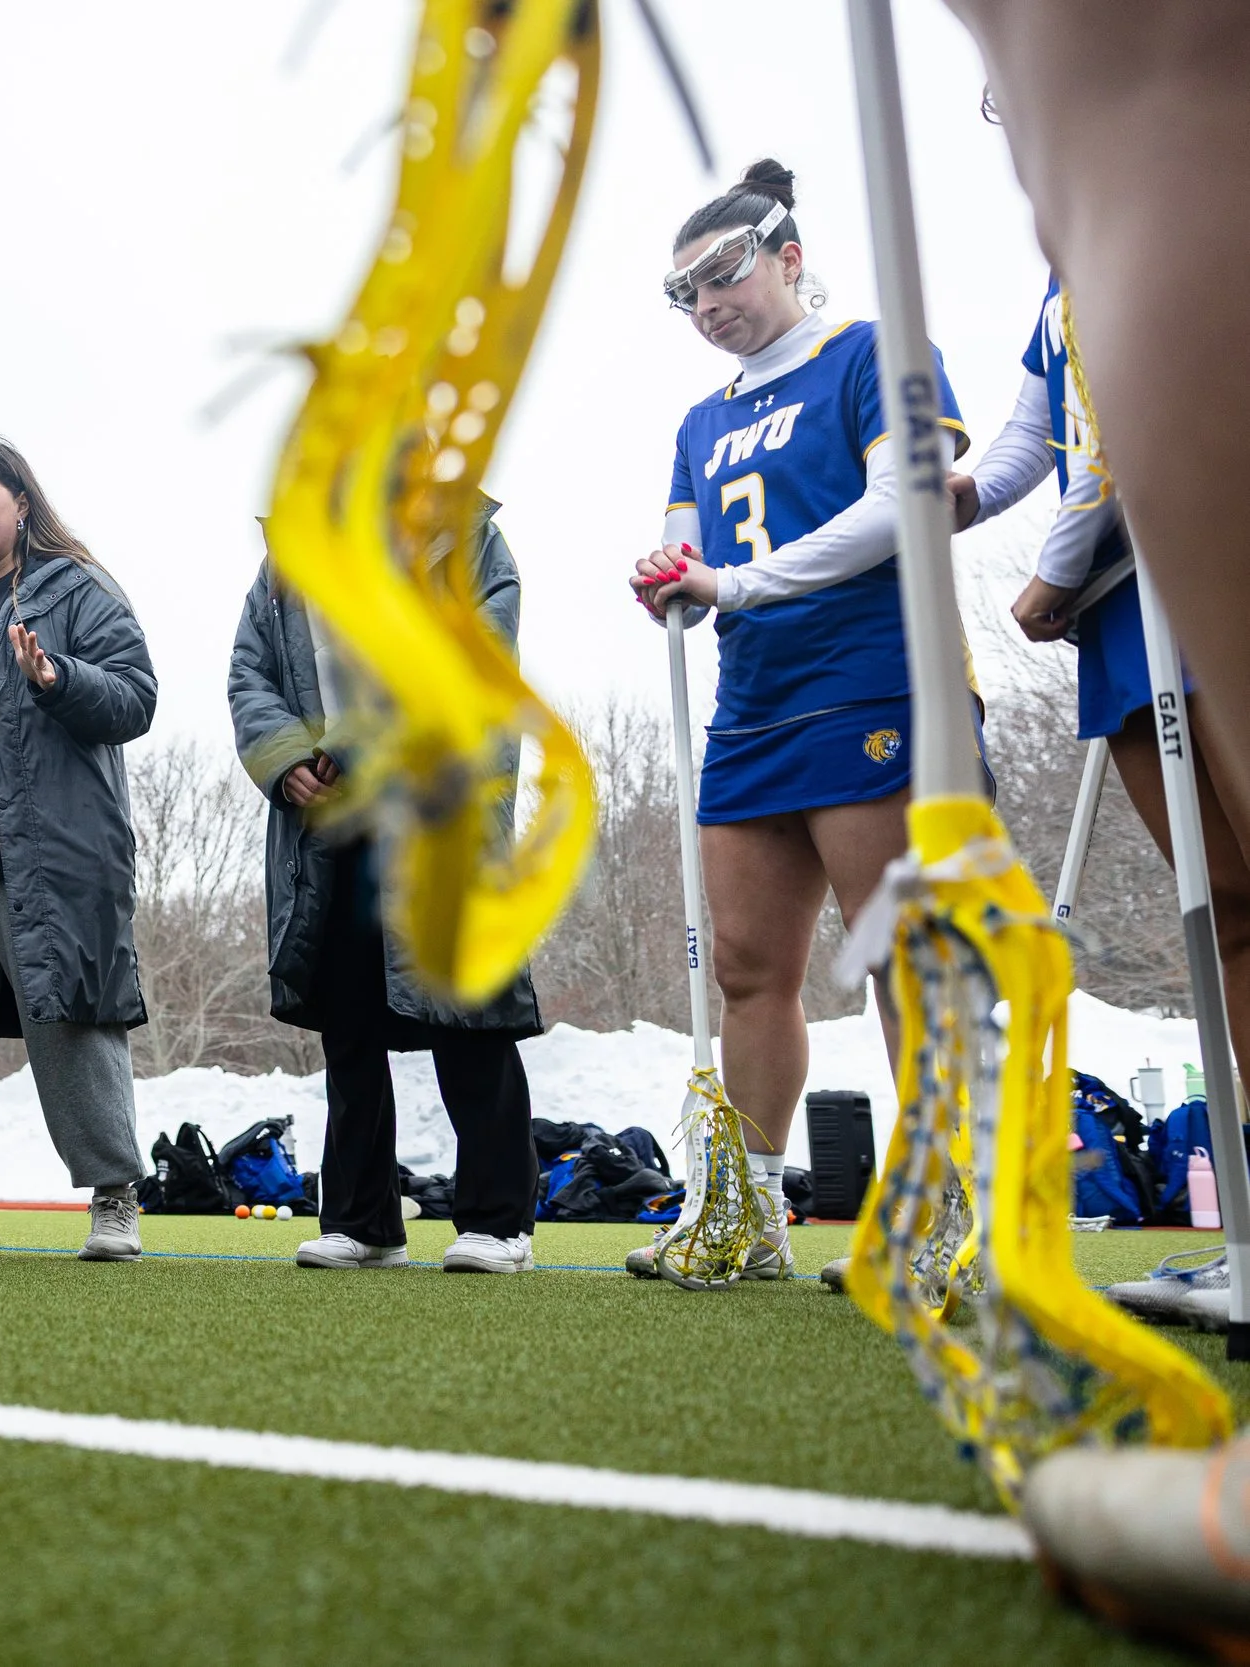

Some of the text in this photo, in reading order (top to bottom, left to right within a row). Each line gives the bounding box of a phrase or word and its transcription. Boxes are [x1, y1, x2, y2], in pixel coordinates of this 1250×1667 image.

[704, 402, 804, 480] JWU
[721, 472, 772, 567] 3
[1158, 692, 1183, 759] GAIT
[687, 925, 698, 968] GAIT
